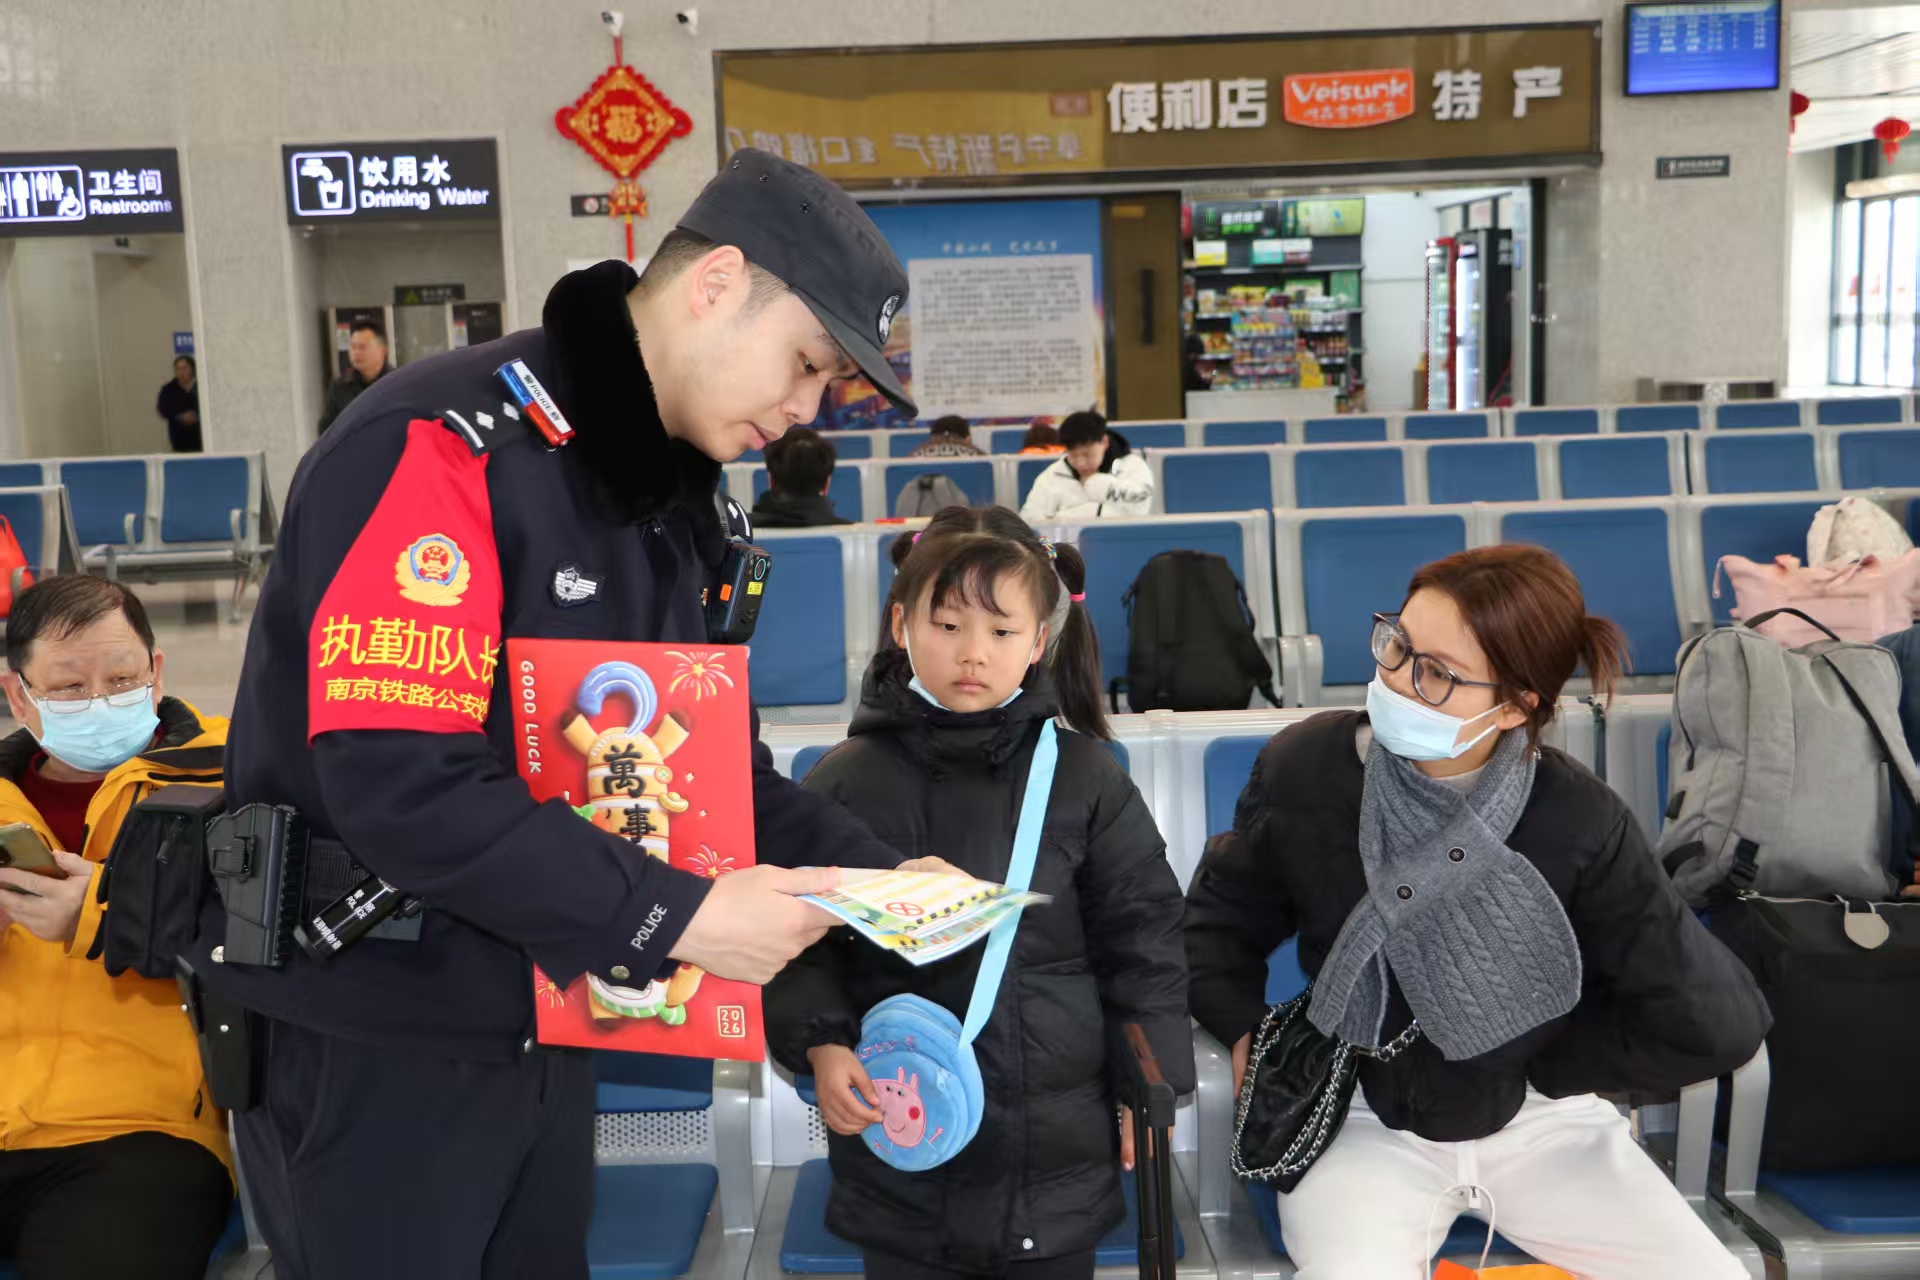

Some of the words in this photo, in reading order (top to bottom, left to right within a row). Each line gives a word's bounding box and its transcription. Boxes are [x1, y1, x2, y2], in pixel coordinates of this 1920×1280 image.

[1107, 78, 1268, 133] 便利店
[1432, 66, 1563, 121] 特产
[604, 105, 645, 144] 福
[88, 168, 163, 197] 卫生间
[359, 155, 452, 188] 饮用水
[89, 198, 173, 216] Restrooms
[359, 188, 431, 210] Drinking
[437, 186, 490, 207] Water
[520, 660, 537, 714] GOOD
[525, 722, 543, 775] LUCK
[630, 902, 669, 951] POLICE
[720, 1009, 740, 1022] 20
[722, 1022, 741, 1034] 26
